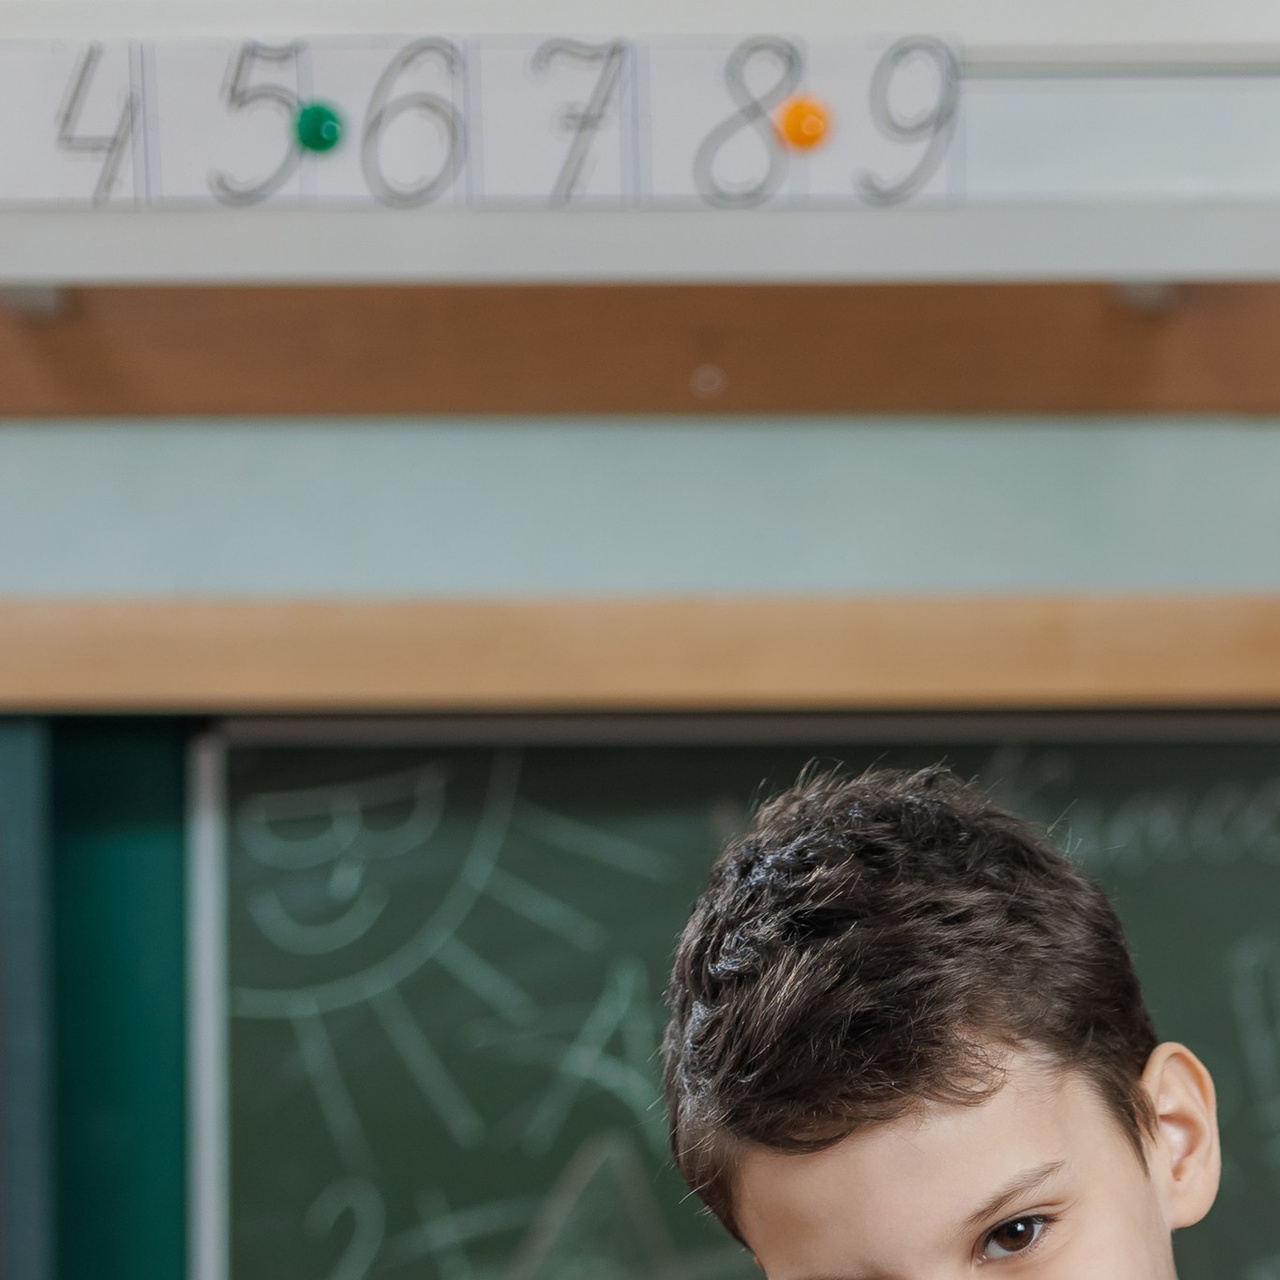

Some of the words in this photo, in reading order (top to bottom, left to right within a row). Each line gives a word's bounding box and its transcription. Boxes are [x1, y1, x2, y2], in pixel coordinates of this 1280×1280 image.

[57, 42, 138, 205] 4
[208, 38, 308, 208] 5
[358, 36, 468, 210] 6
[529, 36, 636, 208] 7
[691, 32, 804, 209] 8
[852, 32, 959, 208] 9
